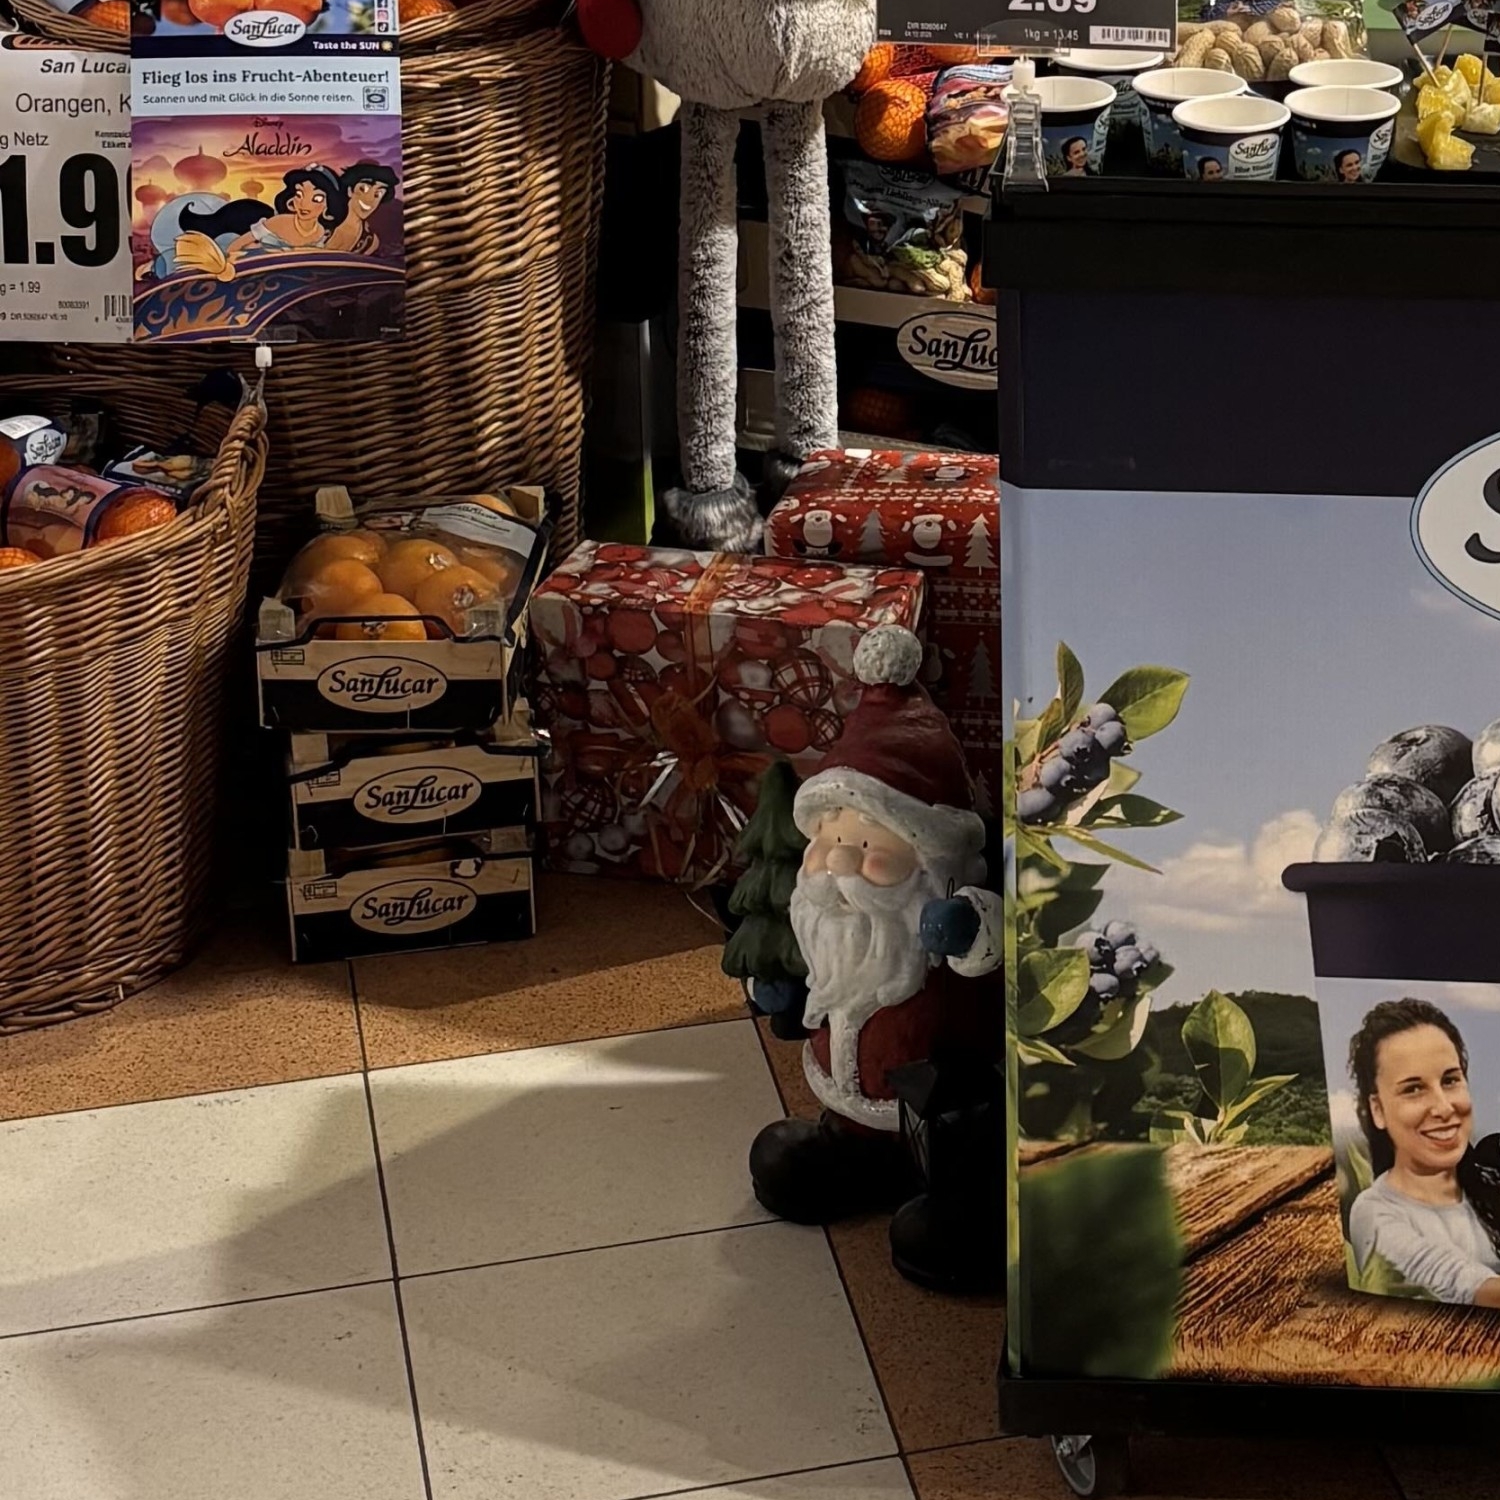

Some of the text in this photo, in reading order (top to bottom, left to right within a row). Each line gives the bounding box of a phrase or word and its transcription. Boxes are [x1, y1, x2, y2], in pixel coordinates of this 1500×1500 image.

[231, 17, 303, 40] SanLucar
[1024, 29, 1041, 41] 1kg
[1053, 29, 1079, 40] 13.45
[313, 40, 380, 50] Taste the SUN
[40, 59, 75, 73] San
[142, 69, 389, 87] Flieg los ins Frucht-Abenteuer!
[16, 93, 111, 118] Orangen,
[143, 92, 355, 104] Scannen und mit Glück in die Sonne reisen.
[253, 117, 284, 129] Disney
[14, 131, 49, 146] Netz
[223, 131, 312, 157] Aladdin
[0, 153, 132, 267] 1.9
[20, 282, 41, 294] 1.99
[329, 666, 439, 702] SanLucar
[365, 775, 474, 815] SanLucar
[361, 887, 469, 926] SanLucar
